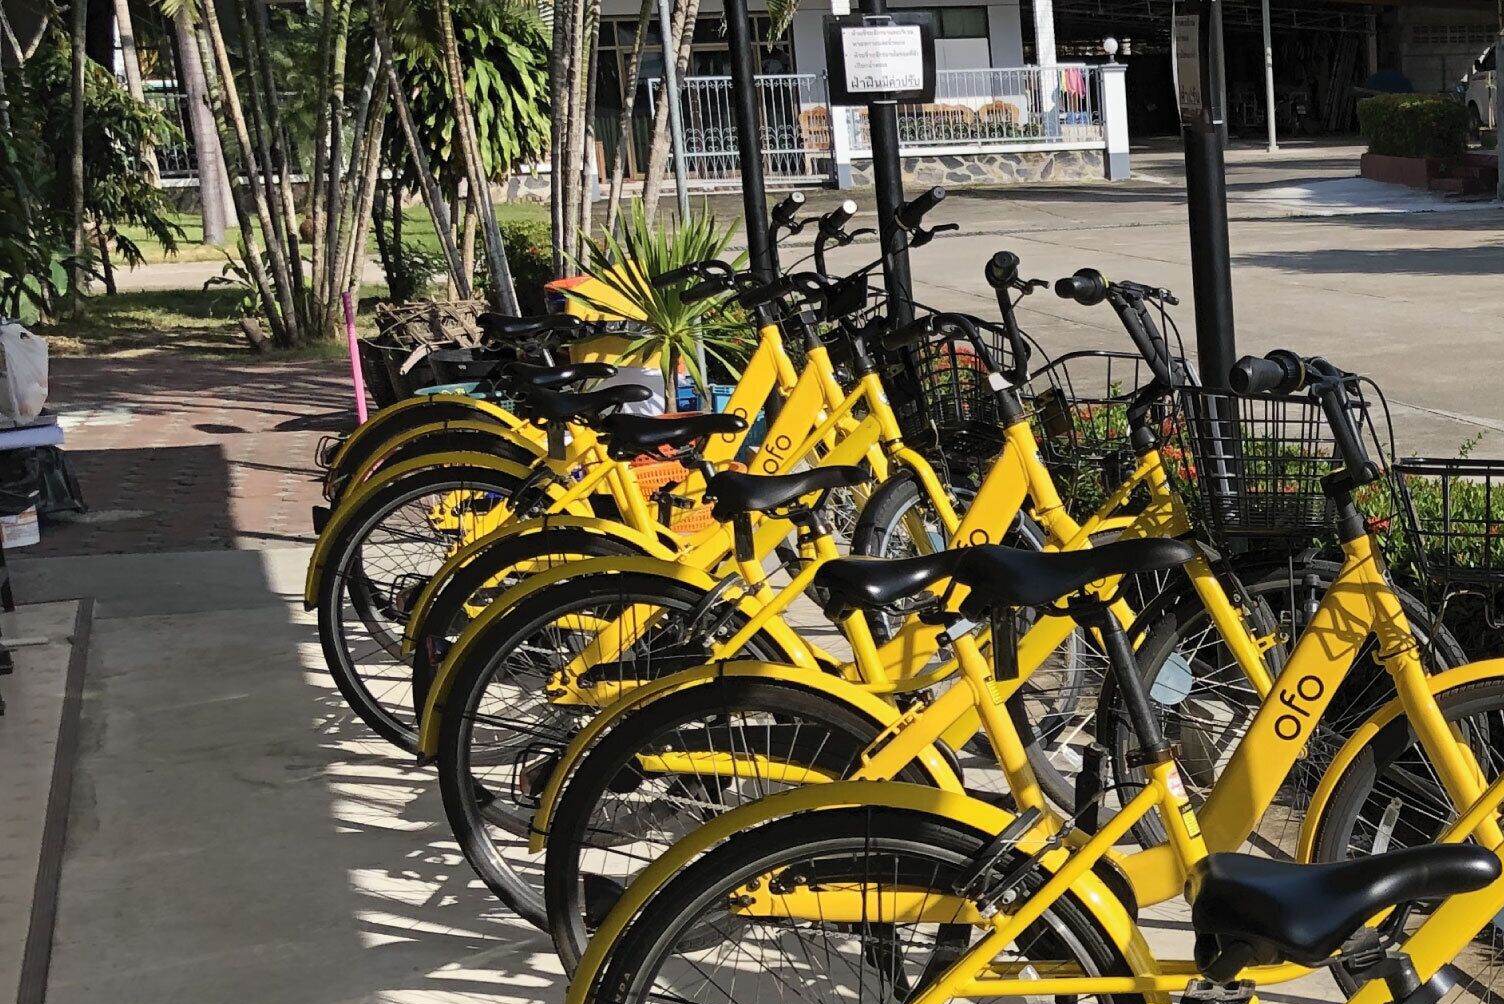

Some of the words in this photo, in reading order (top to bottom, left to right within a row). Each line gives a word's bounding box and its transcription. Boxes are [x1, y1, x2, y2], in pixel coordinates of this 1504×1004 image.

[721, 407, 748, 443] oo
[763, 434, 792, 475] ofo
[1274, 674, 1325, 741] ofo
